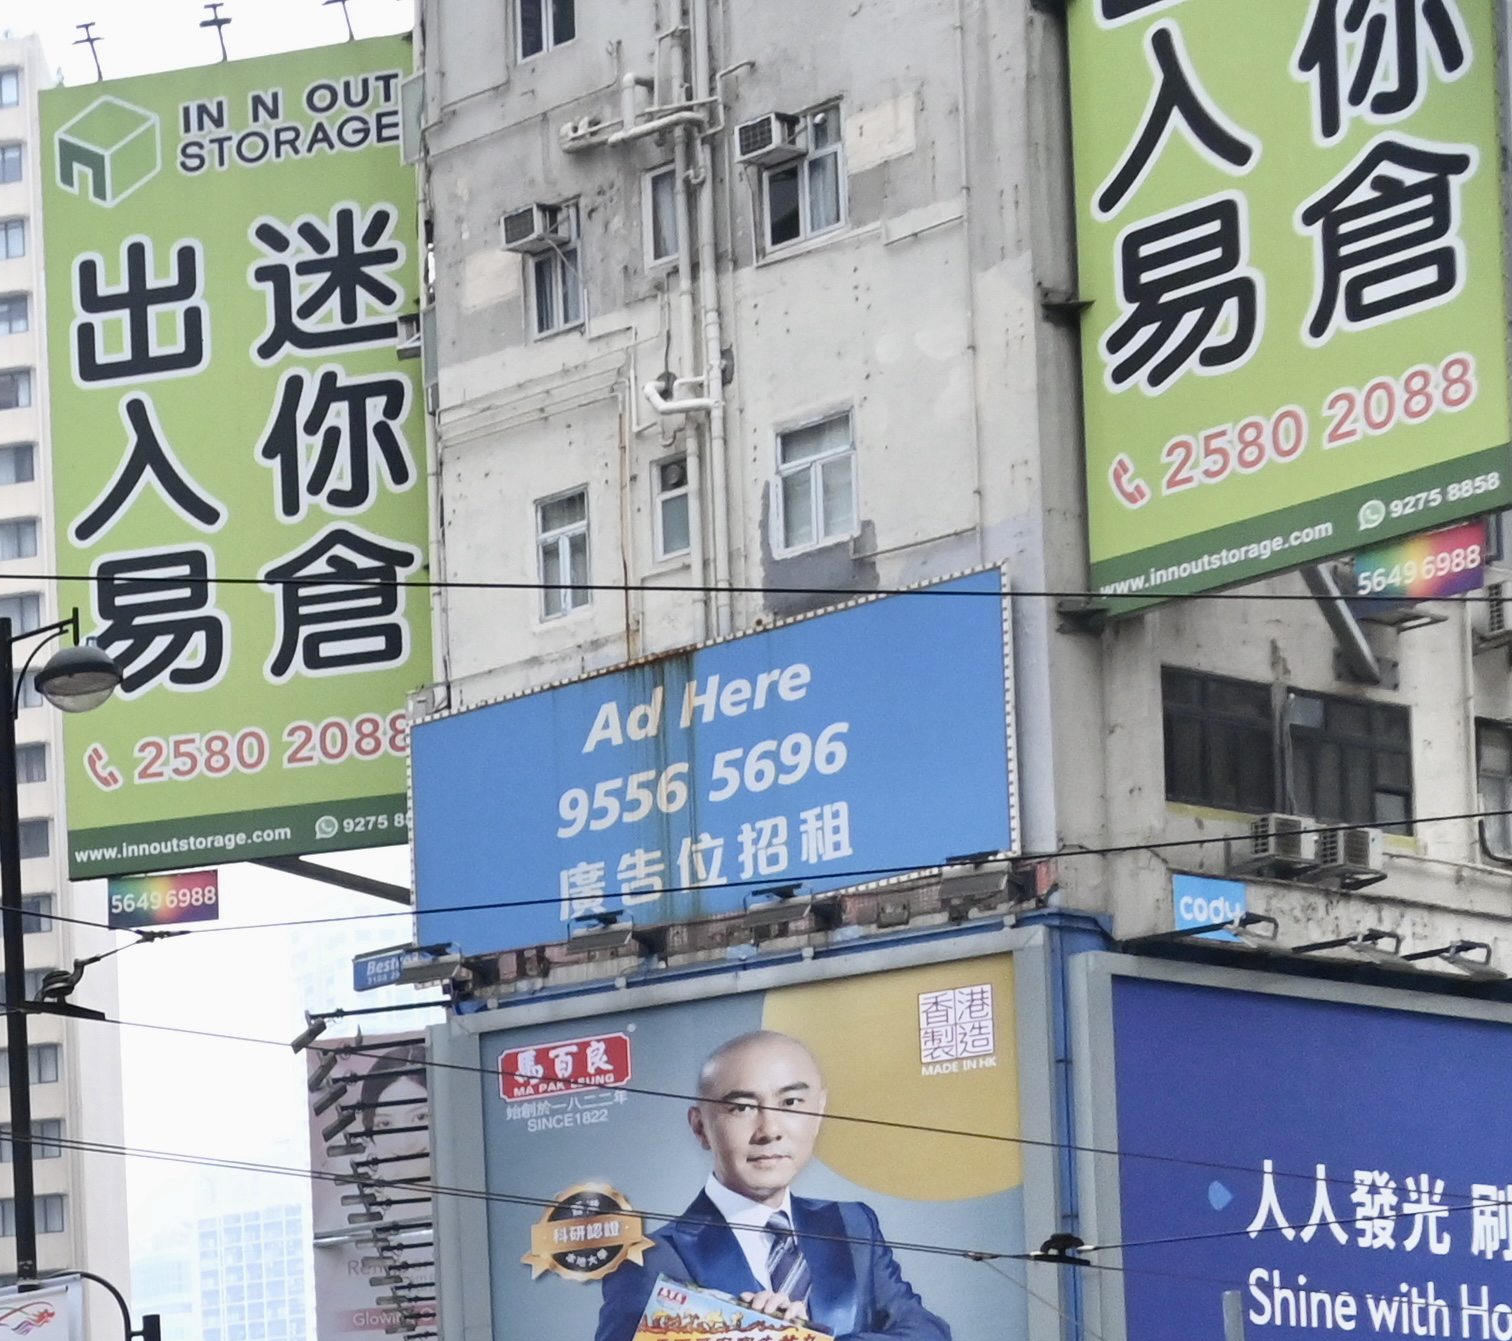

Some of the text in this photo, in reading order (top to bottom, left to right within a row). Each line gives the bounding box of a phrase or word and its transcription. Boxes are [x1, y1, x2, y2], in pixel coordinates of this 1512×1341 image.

[181, 72, 399, 135] IN N OUT
[178, 108, 400, 174] STORAGE
[252, 207, 415, 679] 迷你倉
[1163, 355, 1476, 490] 2580 2088
[74, 240, 224, 694] 出入易
[1099, 471, 1501, 599] www.innoutstorage.com 9275 8858
[1357, 543, 1482, 597] 5649 6988
[582, 661, 812, 755] Ad Here
[136, 711, 409, 782] 2580 2088
[557, 720, 851, 840] 9556 5696
[74, 825, 292, 863] www.innoutstorage.com
[343, 813, 389, 834] 9275
[558, 800, 854, 922] 廣告位招租
[110, 884, 216, 914] 5649 6988
[513, 1080, 565, 1098] MA PAK
[515, 1039, 614, 1085] 馬百良
[921, 1057, 998, 1076] MADE HK
[1246, 1159, 1452, 1256] 人人發光
[1248, 1266, 1450, 1338] Shine with
